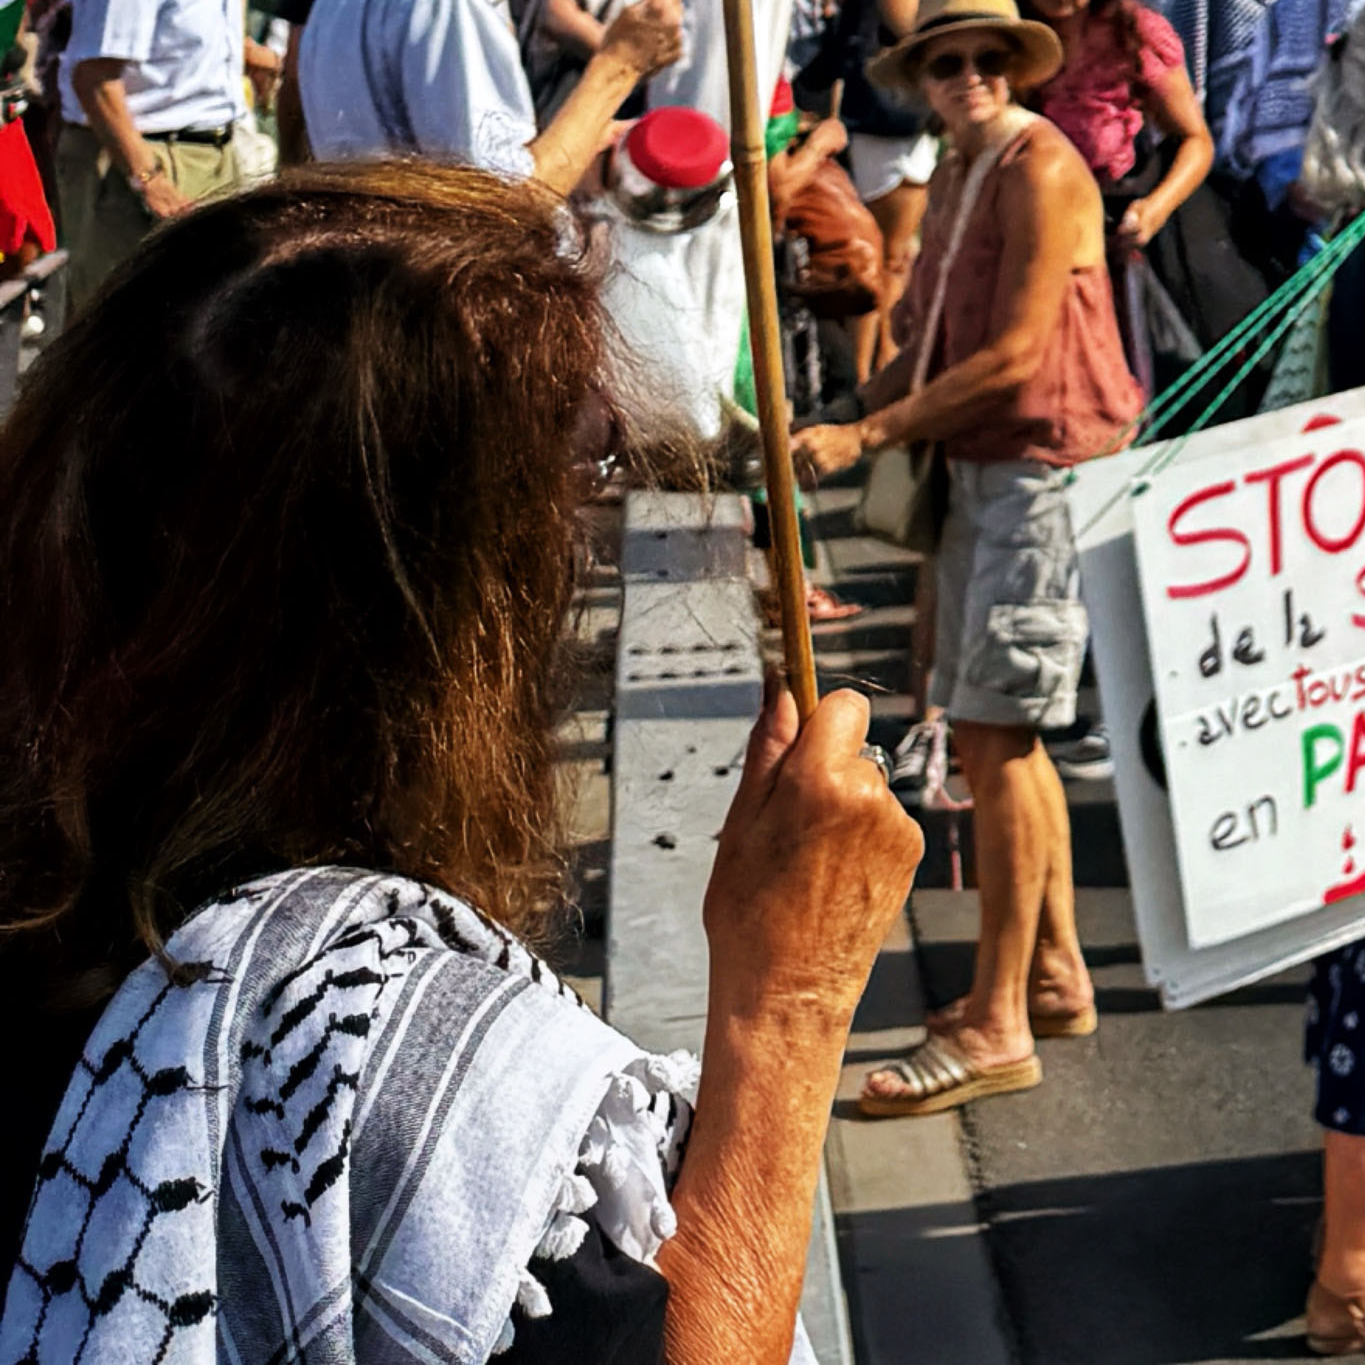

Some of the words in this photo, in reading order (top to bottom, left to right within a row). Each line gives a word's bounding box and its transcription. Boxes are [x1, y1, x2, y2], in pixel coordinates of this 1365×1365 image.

[1200, 611, 1265, 678] de
[1198, 691, 1293, 746] avec
[1209, 795, 1279, 851] en
